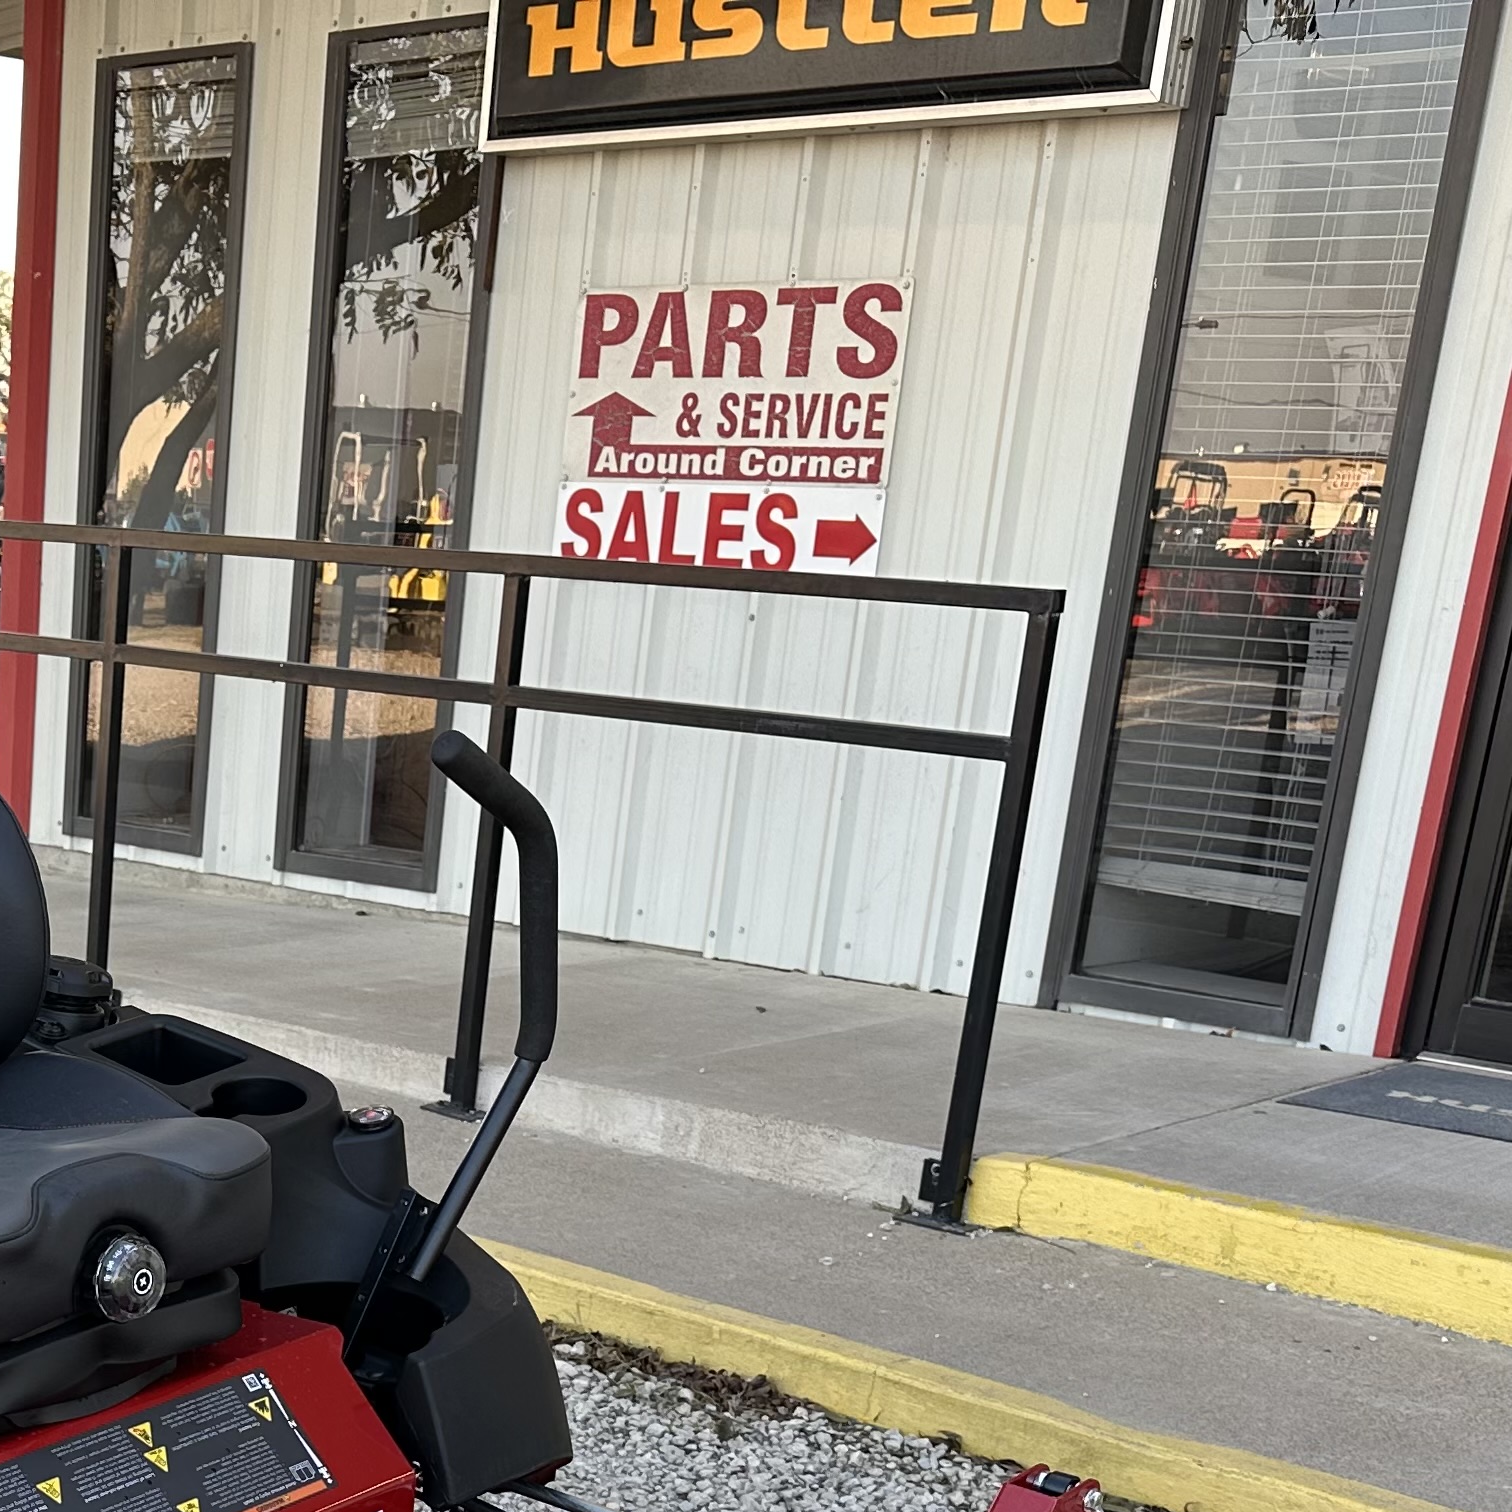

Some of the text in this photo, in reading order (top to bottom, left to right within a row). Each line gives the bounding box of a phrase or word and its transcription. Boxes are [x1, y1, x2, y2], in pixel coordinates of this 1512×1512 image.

[578, 283, 904, 380] PARTS
[675, 391, 890, 440] & SERVICE
[593, 446, 876, 479] Around Corner
[560, 488, 799, 572] SALES
